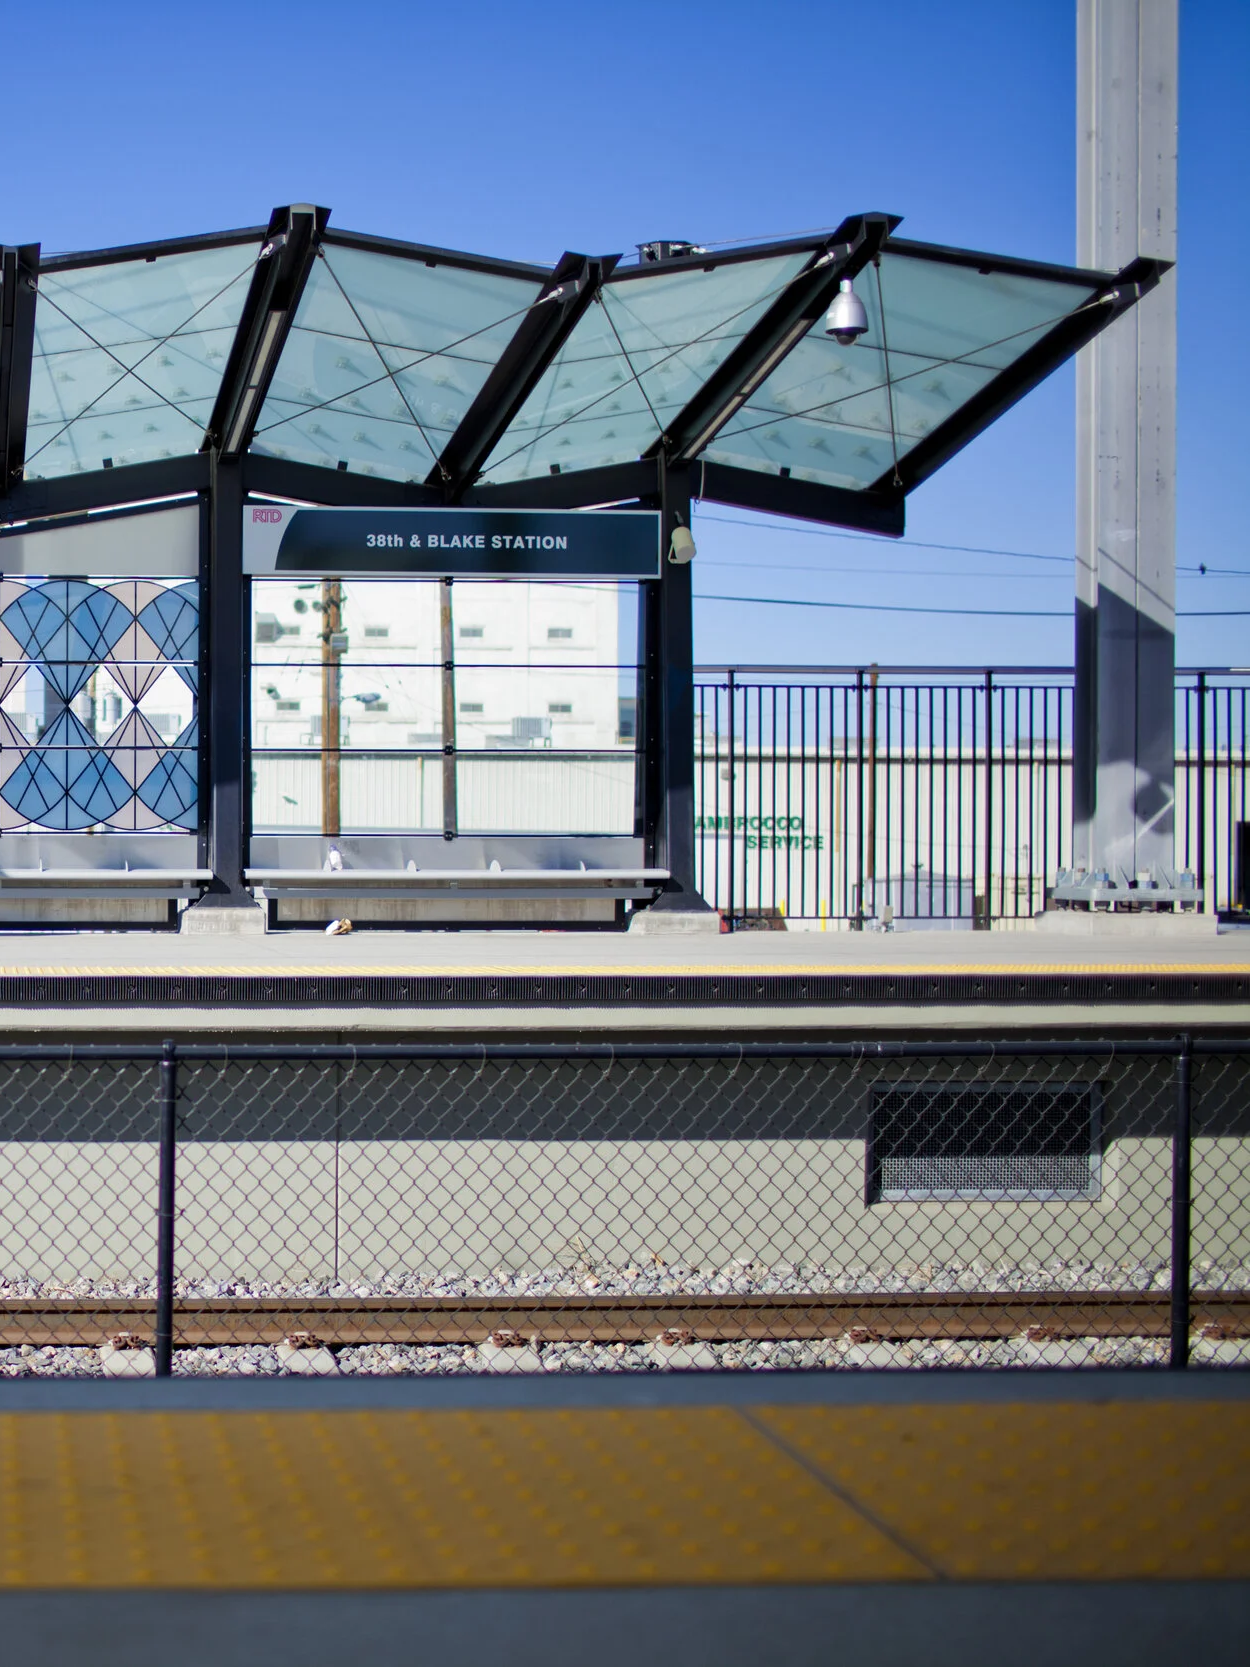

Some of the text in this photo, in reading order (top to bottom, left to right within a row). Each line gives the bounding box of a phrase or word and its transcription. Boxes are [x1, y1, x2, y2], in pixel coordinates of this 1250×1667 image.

[252, 508, 283, 524] RTD
[366, 534, 568, 550] 38th & BLAKE STATION
[746, 835, 825, 850] SERVICE
